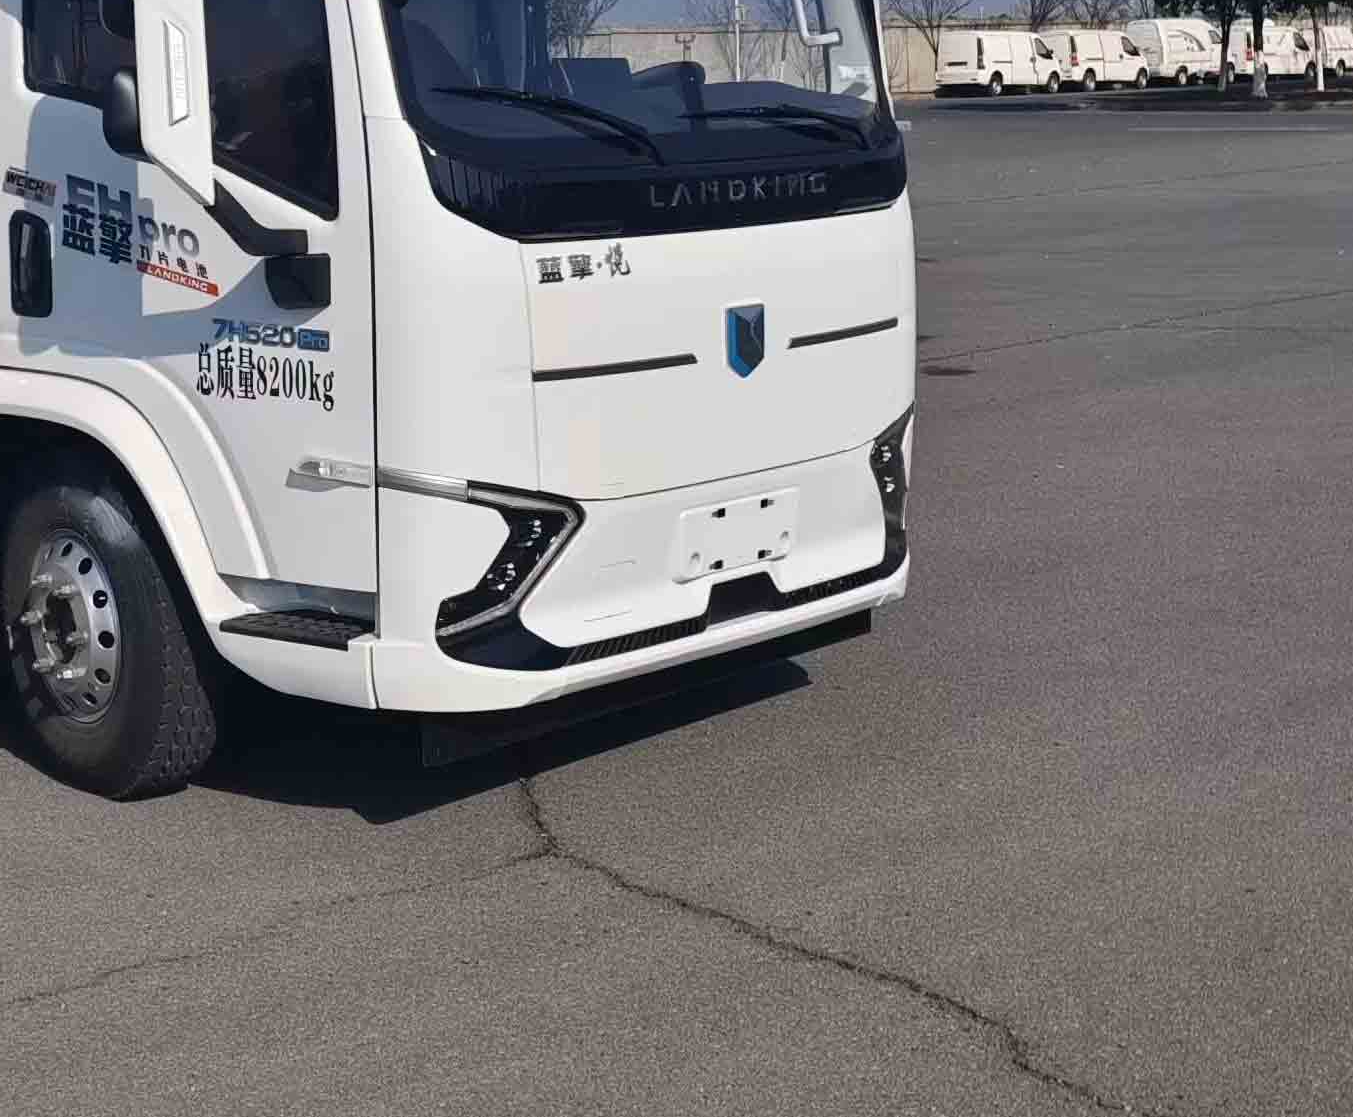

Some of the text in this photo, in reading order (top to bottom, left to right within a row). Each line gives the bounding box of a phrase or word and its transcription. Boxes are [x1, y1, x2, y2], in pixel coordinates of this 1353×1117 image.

[650, 172, 825, 207] LANDKING
[61, 204, 132, 264] 蓝擎
[146, 265, 209, 293] LANDKING
